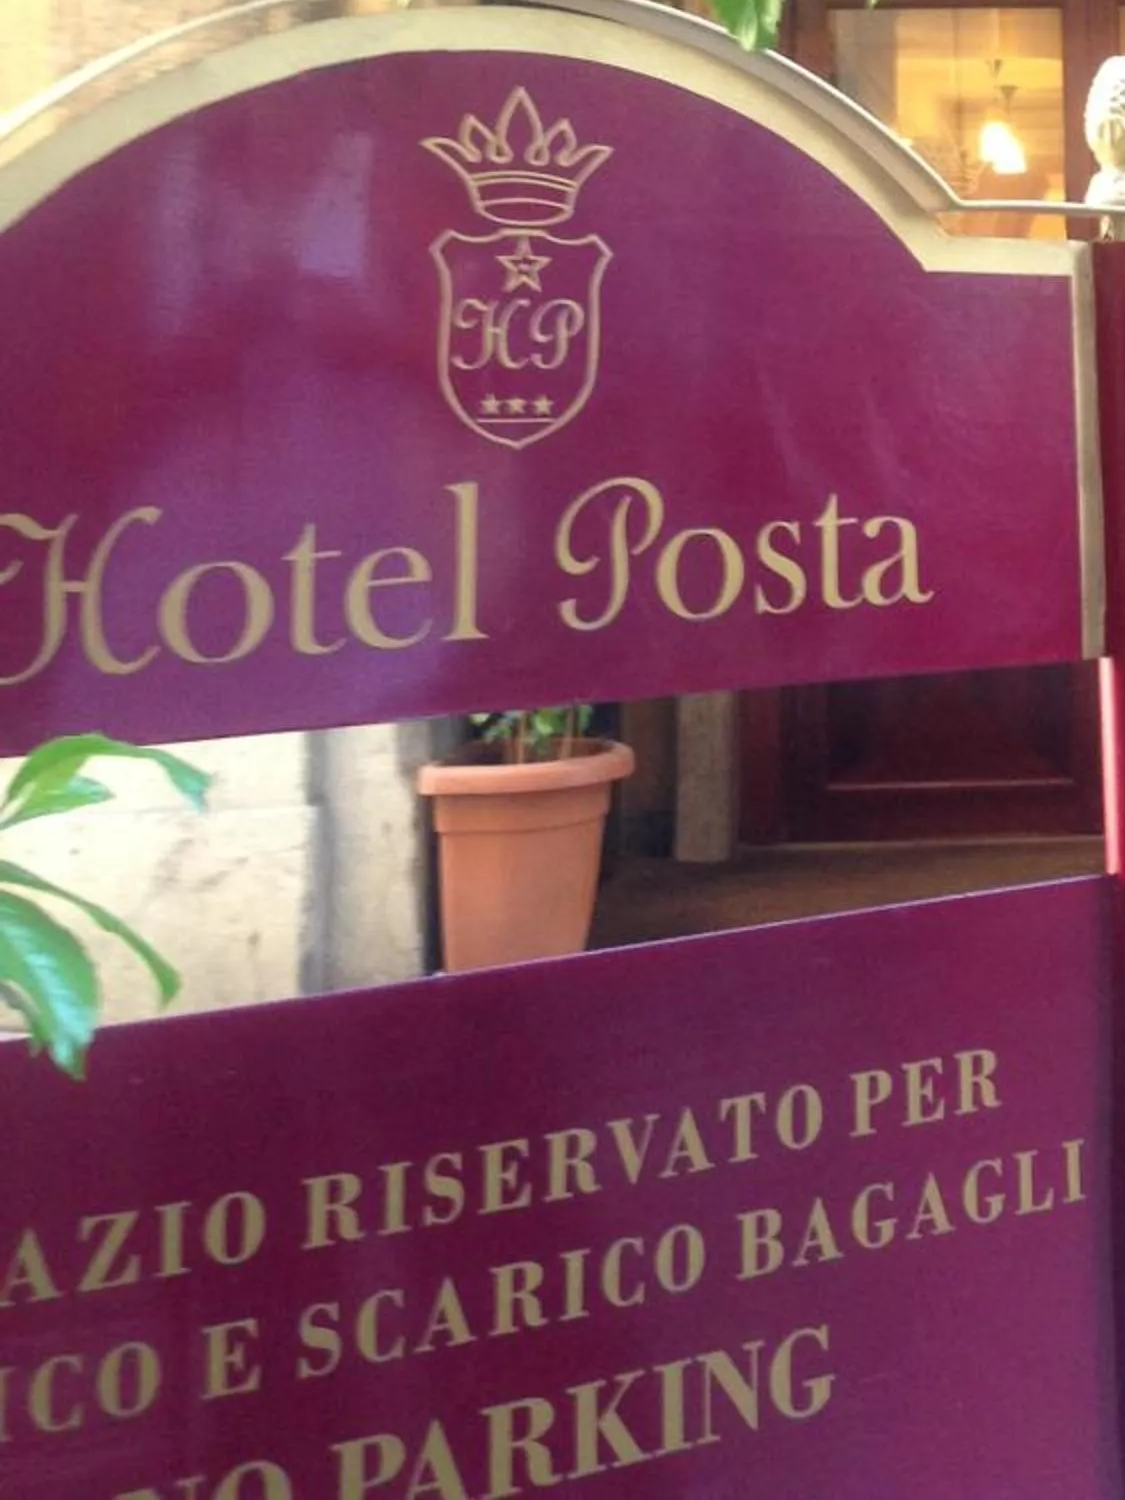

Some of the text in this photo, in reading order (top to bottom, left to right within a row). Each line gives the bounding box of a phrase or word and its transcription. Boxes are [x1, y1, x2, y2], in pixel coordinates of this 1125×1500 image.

[451, 298, 585, 371] HP
[0, 476, 935, 686] Hotel Posta
[0, 1047, 1002, 1308] AZIO RISERVATO PER
[200, 1317, 261, 1401] E
[297, 1224, 705, 1379] SCARICO
[736, 1137, 1088, 1280] BAGAGLI
[328, 1324, 836, 1500] PARKING
